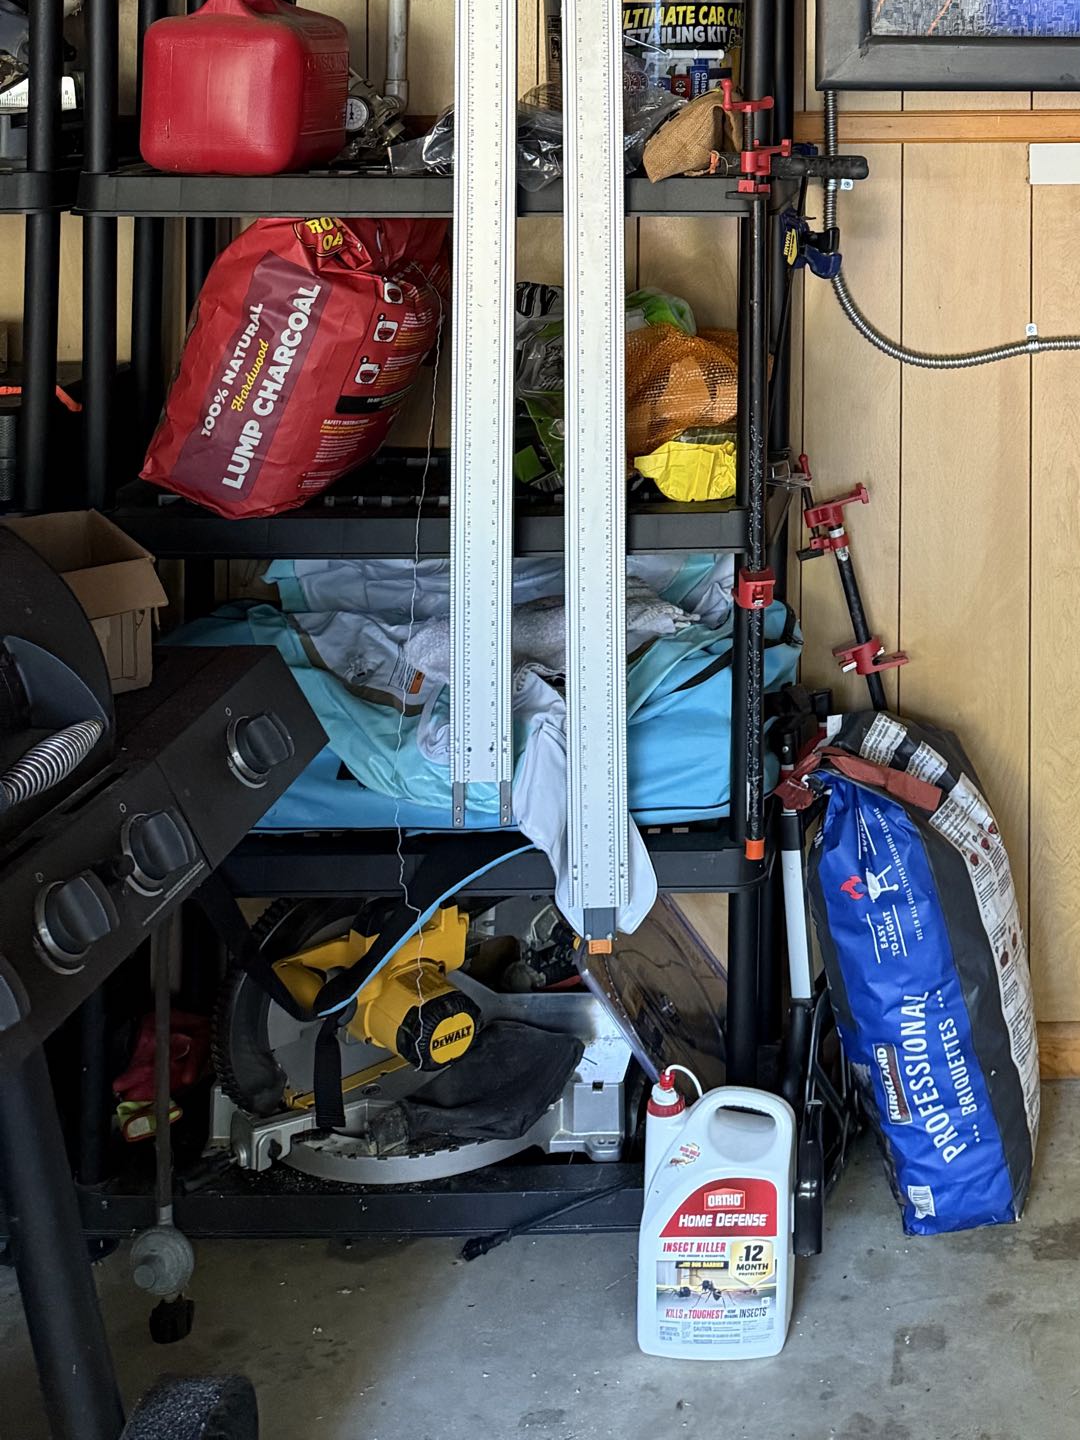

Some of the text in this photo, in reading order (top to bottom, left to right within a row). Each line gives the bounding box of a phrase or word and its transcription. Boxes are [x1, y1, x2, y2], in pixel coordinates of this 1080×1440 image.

[623, 5, 696, 29] LTIMATE
[698, 4, 725, 26] CAR
[624, 25, 728, 47] ETAILING KIT
[783, 231, 792, 256] IRWIN
[201, 303, 264, 437] 100% NATURAL
[230, 338, 270, 412] Hardwood
[222, 419, 263, 490] LUMP
[252, 283, 322, 417] CHARCOAL
[897, 868, 909, 887] TYPES
[876, 924, 889, 950] EASY
[900, 992, 968, 1164] PROFESSIONAL
[938, 1017, 978, 1117] BRIQUETTES
[877, 1047, 902, 1121] KIRKLAND
[707, 1193, 743, 1208] ORTHO
[678, 1212, 768, 1228] HOME DEFENSE
[663, 1242, 726, 1253] INSECT KILLER
[743, 1245, 764, 1262] 12
[736, 1263, 769, 1272] MONTH
[665, 1308, 683, 1319] KILLS
[688, 1309, 724, 1320] TOUGHEST
[739, 1307, 768, 1318] INSECTS
